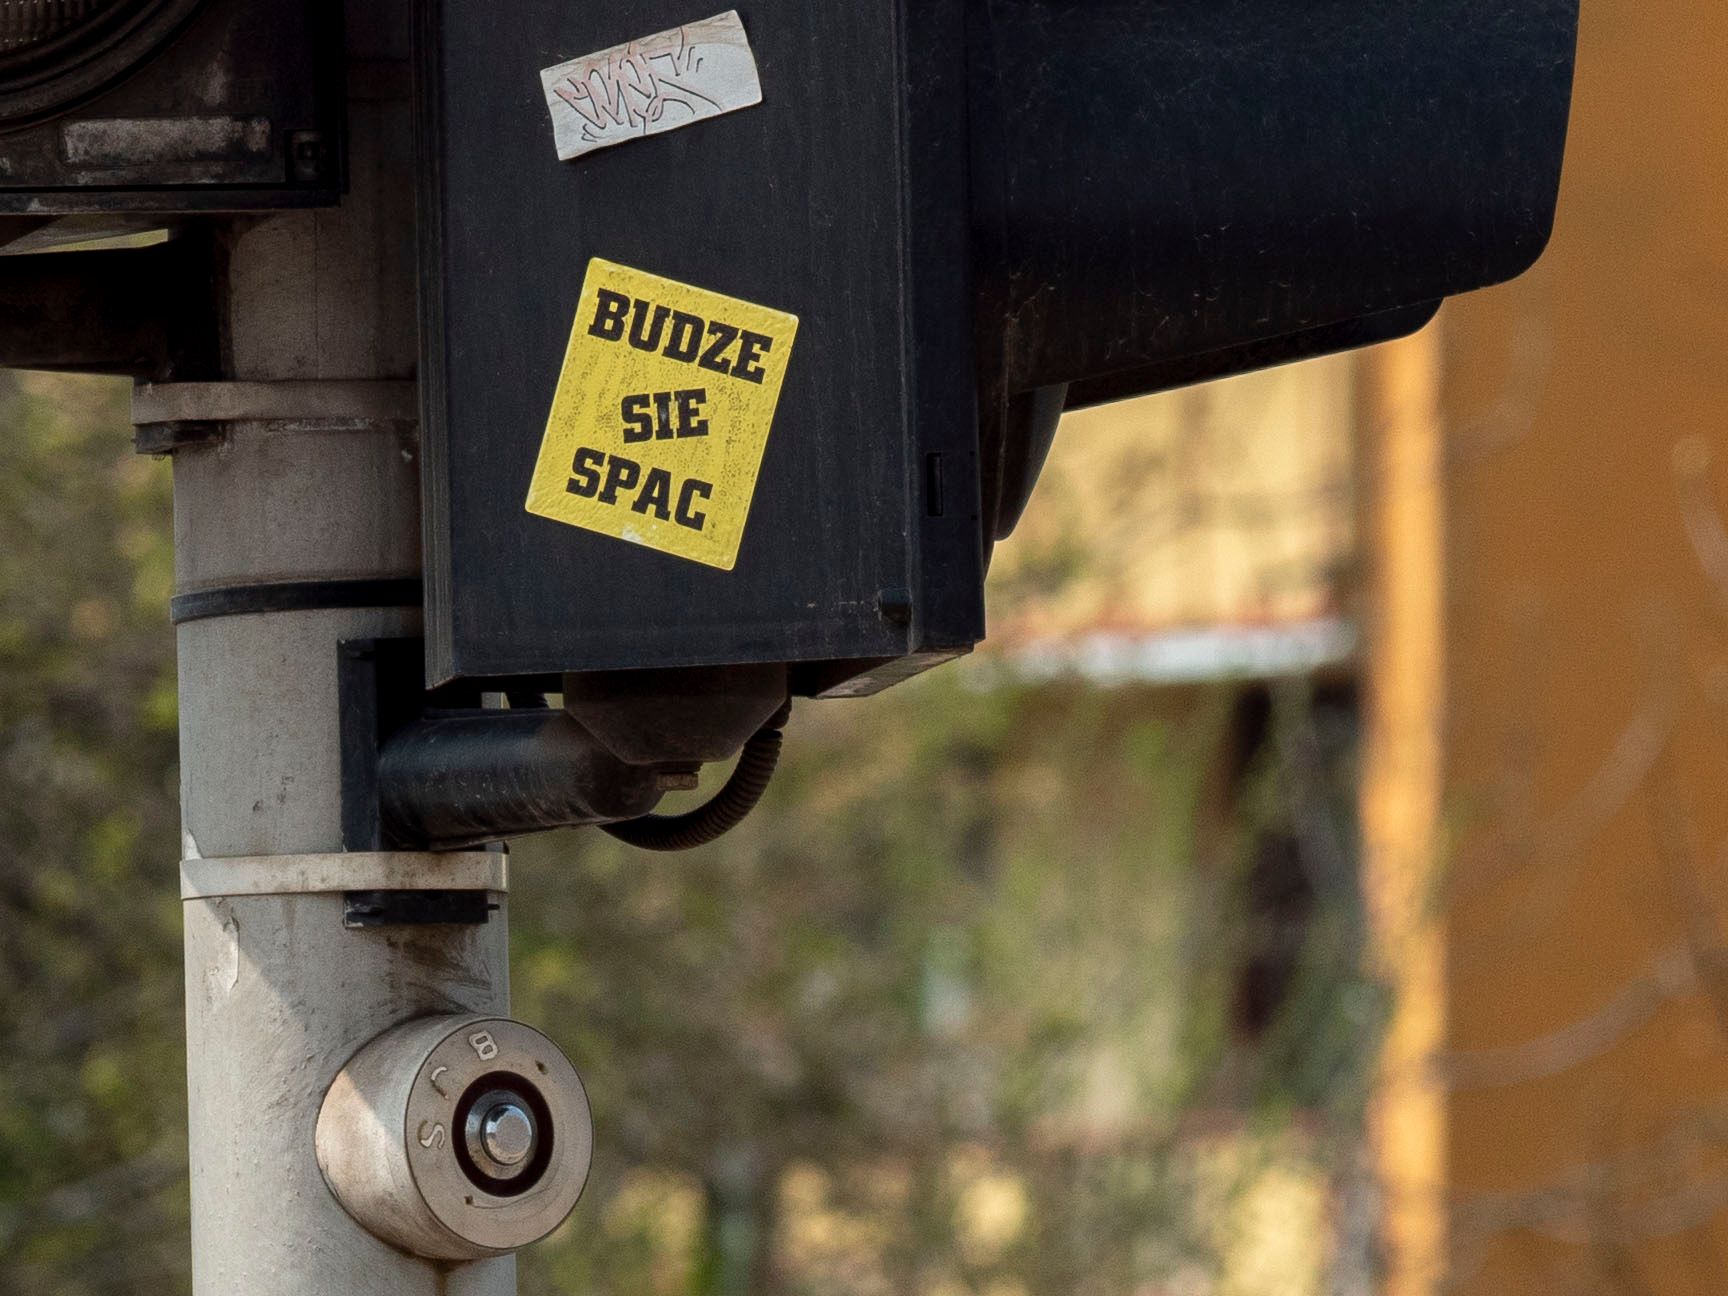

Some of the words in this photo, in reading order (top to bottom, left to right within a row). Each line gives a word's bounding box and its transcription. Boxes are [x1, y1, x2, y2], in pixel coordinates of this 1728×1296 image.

[587, 287, 774, 385] BUDZE
[621, 387, 709, 444] SIE
[565, 446, 714, 532] SPAC
